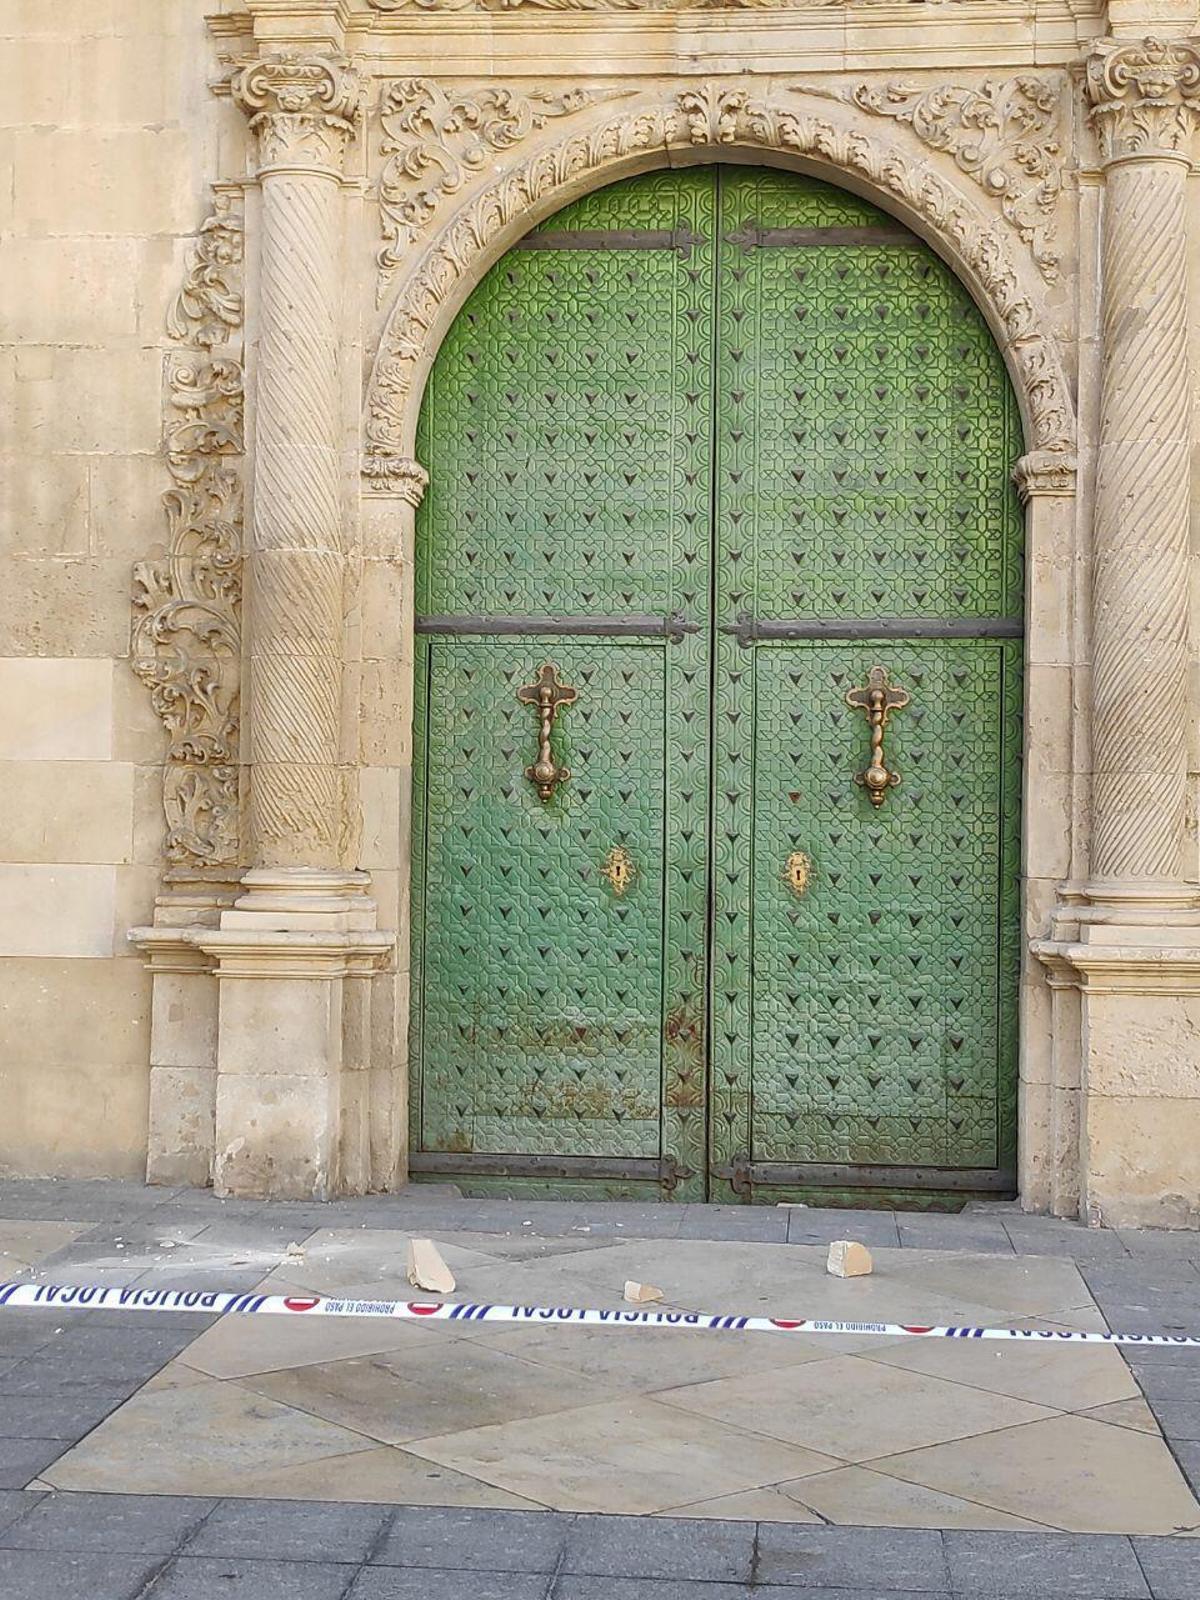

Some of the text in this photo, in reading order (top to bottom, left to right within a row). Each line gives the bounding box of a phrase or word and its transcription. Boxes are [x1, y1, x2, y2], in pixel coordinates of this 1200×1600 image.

[34, 1286, 219, 1307] POLICIA LOCAL
[324, 1302, 396, 1314] PROHIBIDO EL PASO
[813, 1321, 833, 1330] PASO
